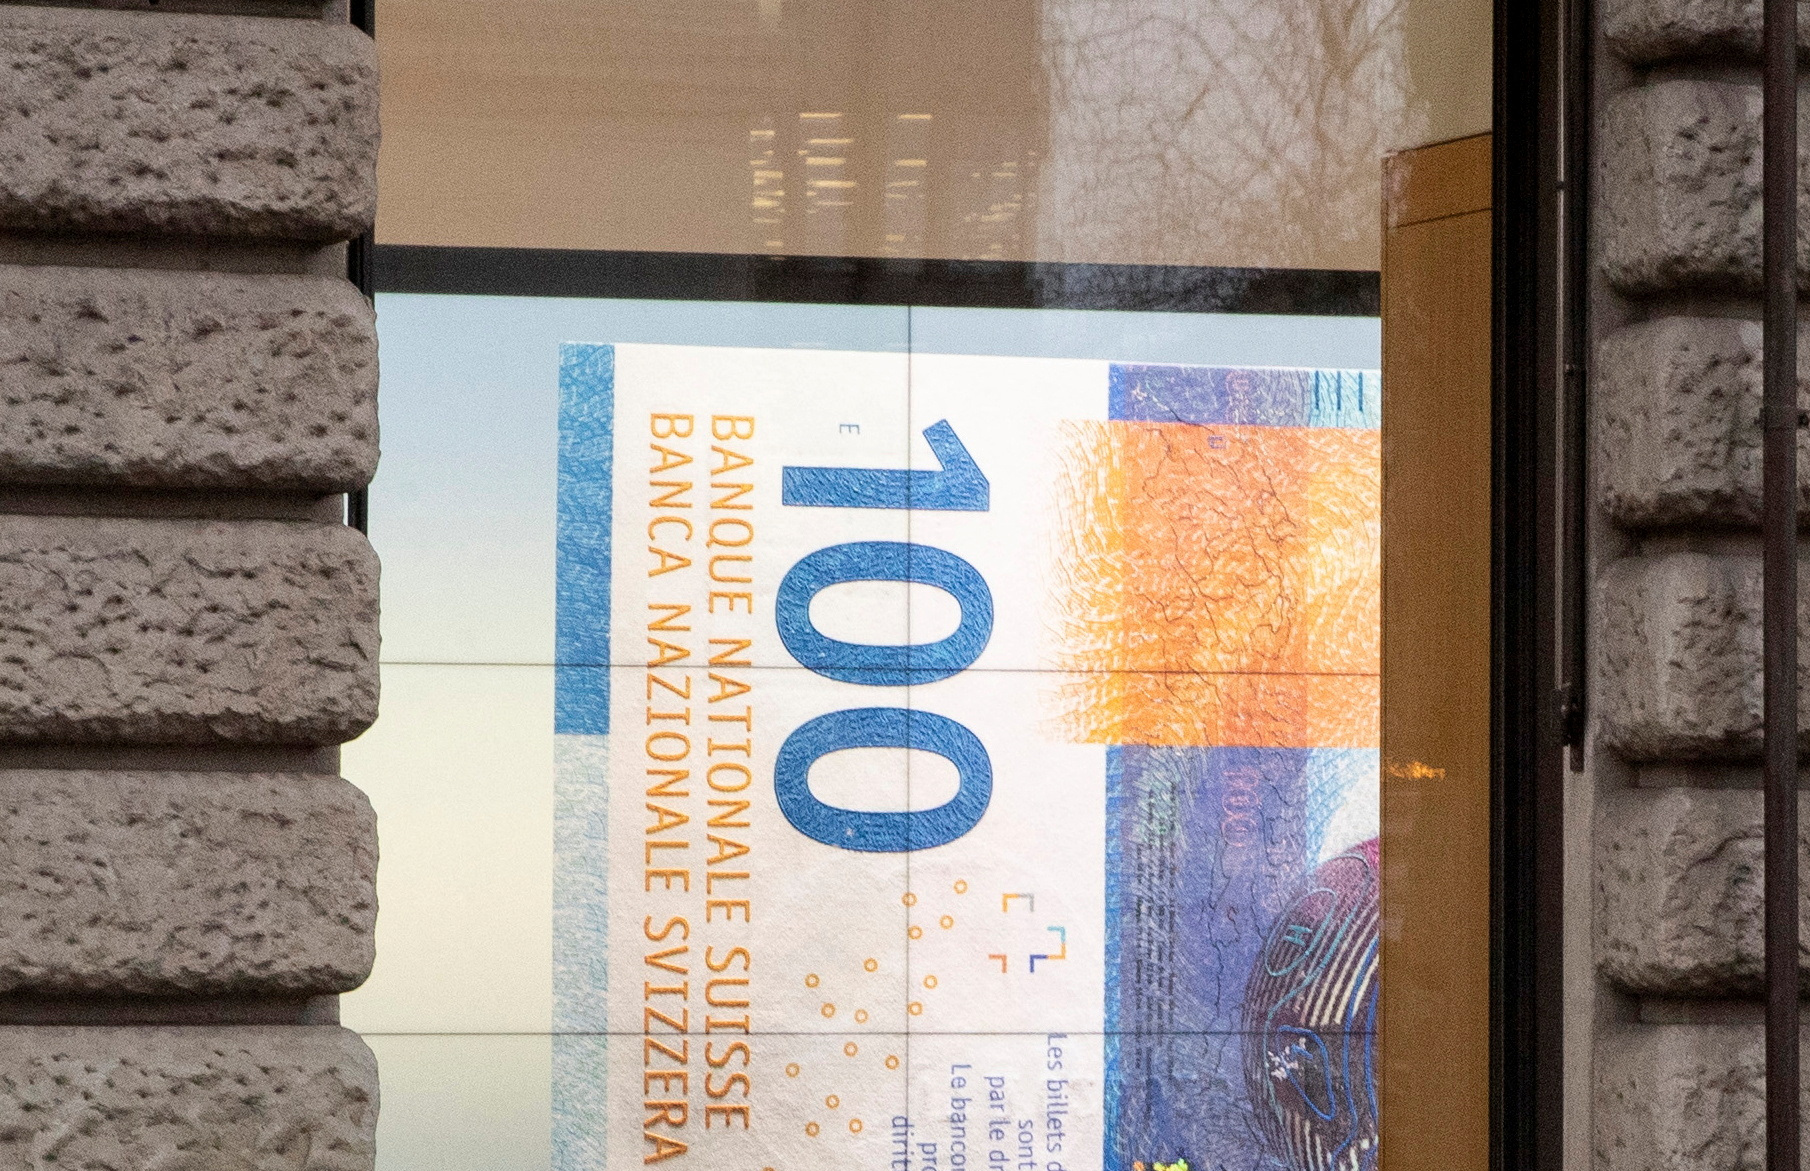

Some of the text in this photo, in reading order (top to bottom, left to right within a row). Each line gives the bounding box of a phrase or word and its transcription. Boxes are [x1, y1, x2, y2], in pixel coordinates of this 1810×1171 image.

[838, 423, 861, 435] E
[773, 419, 994, 853] 100
[642, 411, 695, 1167] BANCA NAZIONALE SVIZZERA
[703, 413, 756, 1131] BANQUE NATIONALE SUISSE
[1046, 1032, 1068, 1071] Les
[950, 1063, 972, 1089] Le
[983, 1076, 1006, 1112] par
[988, 1119, 1011, 1141] le
[1045, 1079, 1069, 1153] billets
[1017, 1119, 1037, 1171] sont
